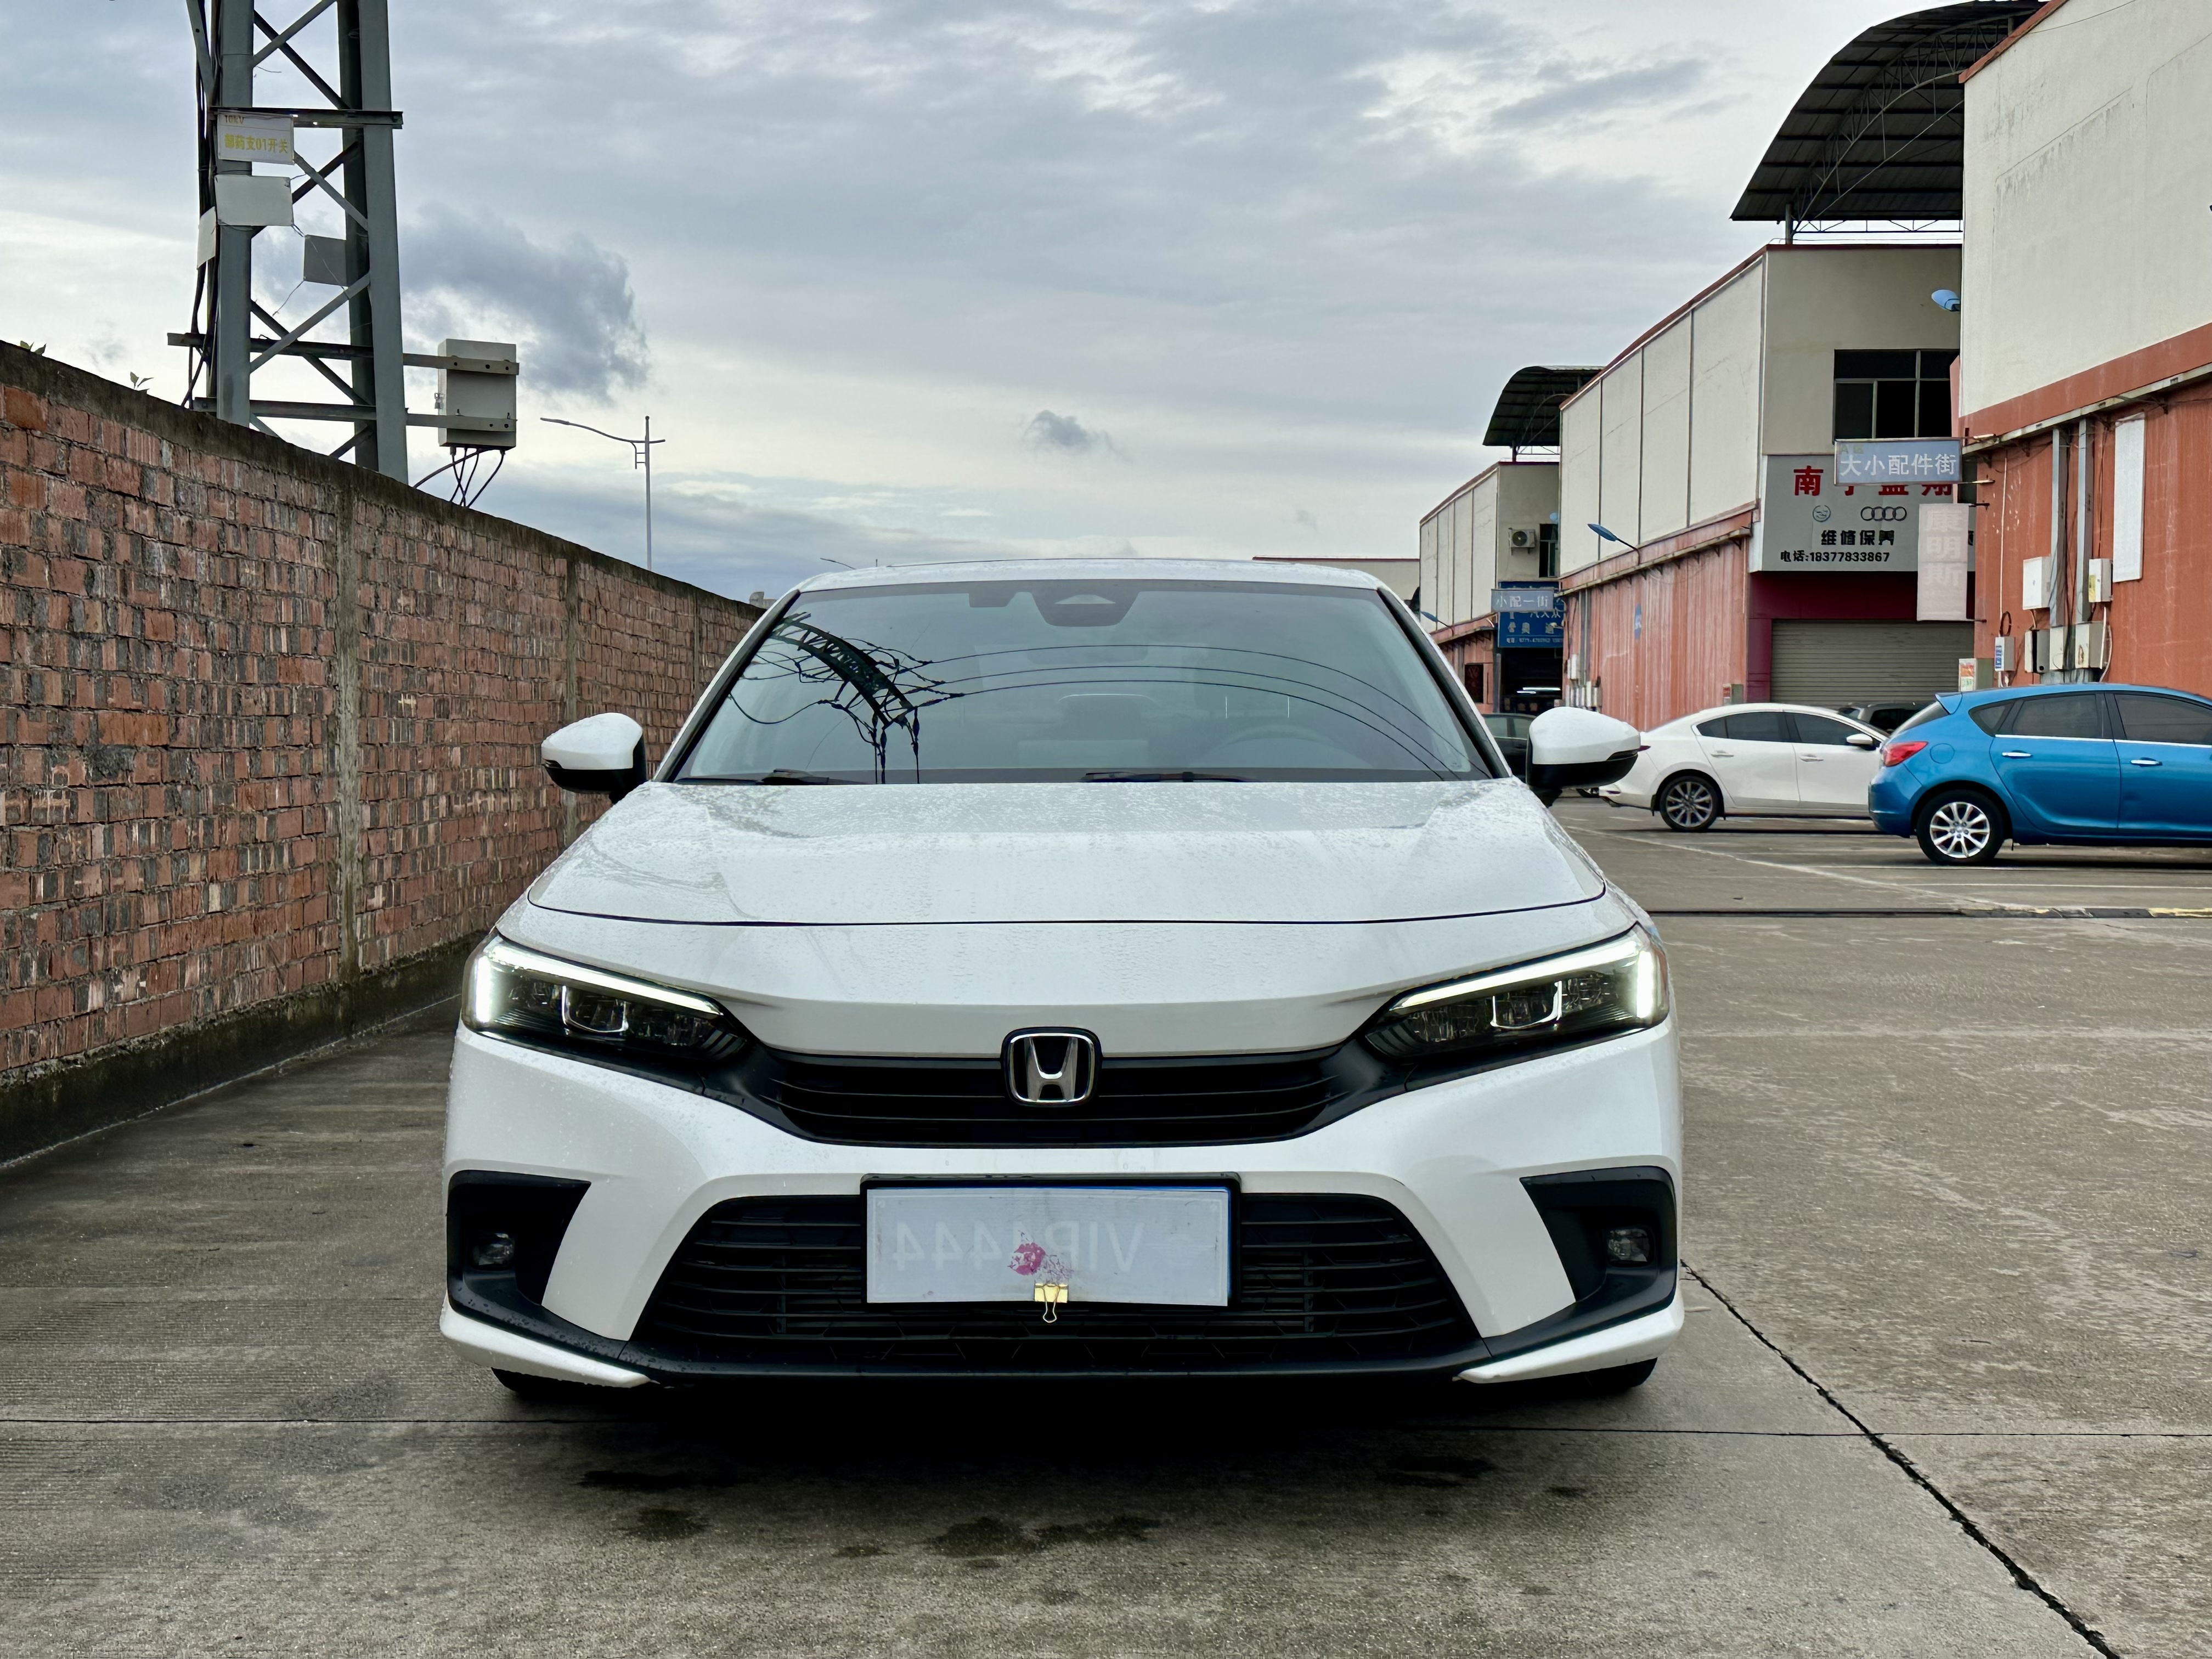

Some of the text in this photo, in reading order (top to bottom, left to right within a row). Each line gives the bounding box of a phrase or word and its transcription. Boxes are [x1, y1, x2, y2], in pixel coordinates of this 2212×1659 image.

[1840, 453, 1957, 476] 大小配件街
[1922, 509, 1962, 586] 康明斯
